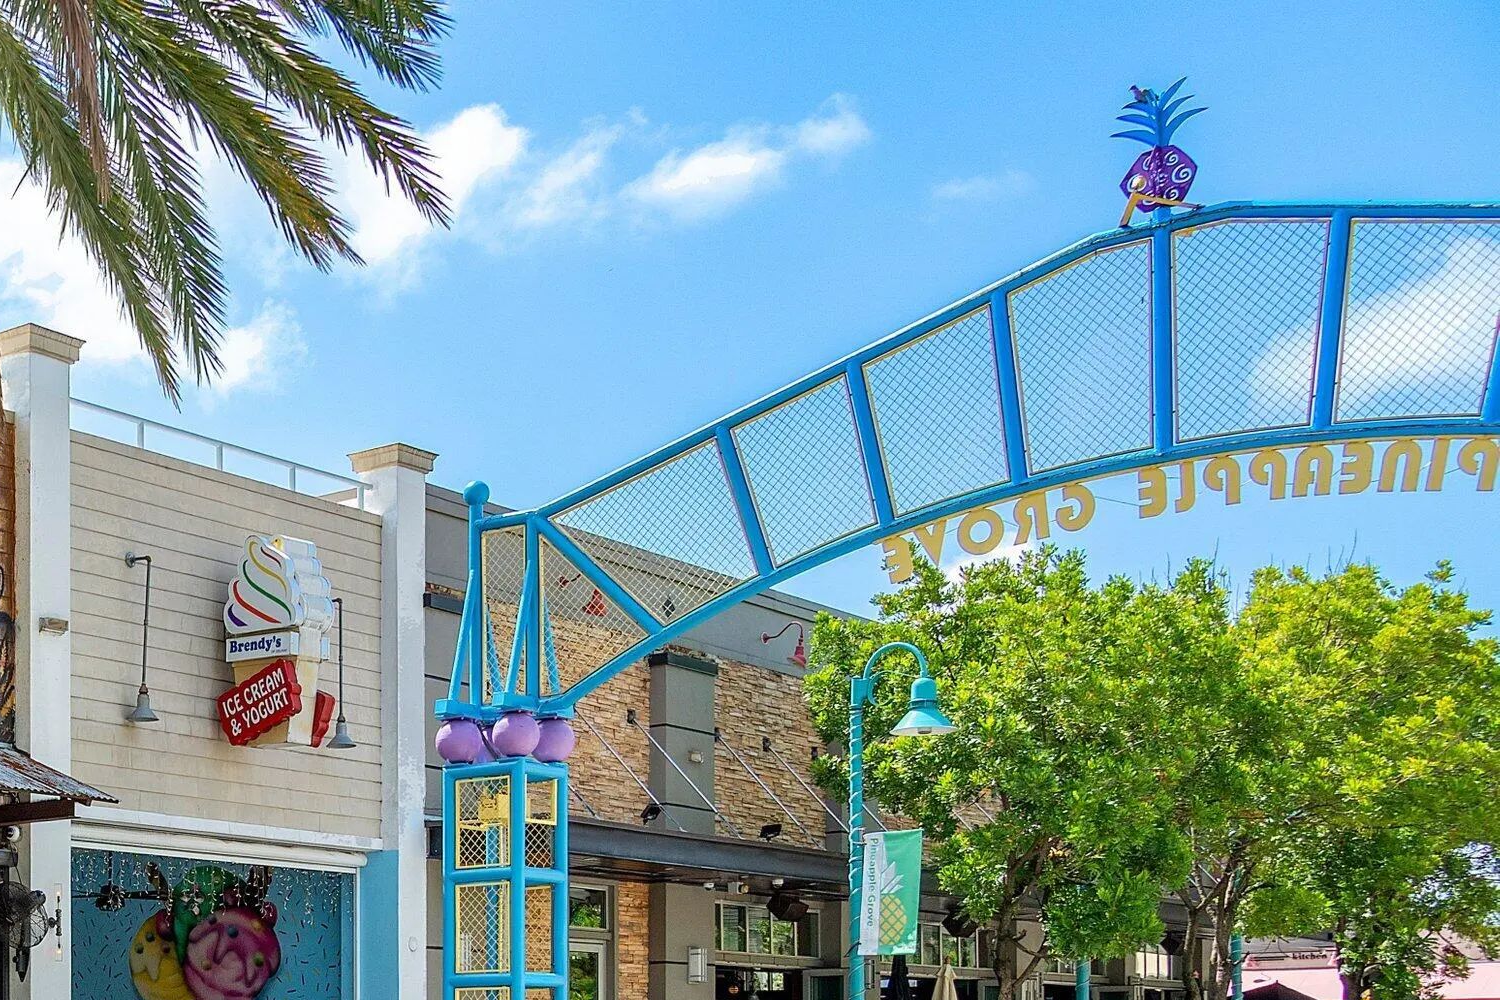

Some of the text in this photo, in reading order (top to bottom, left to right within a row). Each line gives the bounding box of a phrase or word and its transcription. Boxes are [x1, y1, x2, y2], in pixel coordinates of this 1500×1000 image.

[230, 636, 281, 653] Brendy's
[222, 667, 284, 719] ICE CREAM
[230, 688, 289, 736] & YOGURT
[866, 837, 879, 927] Pineapple Grove
[1292, 952, 1328, 960] kitchen
